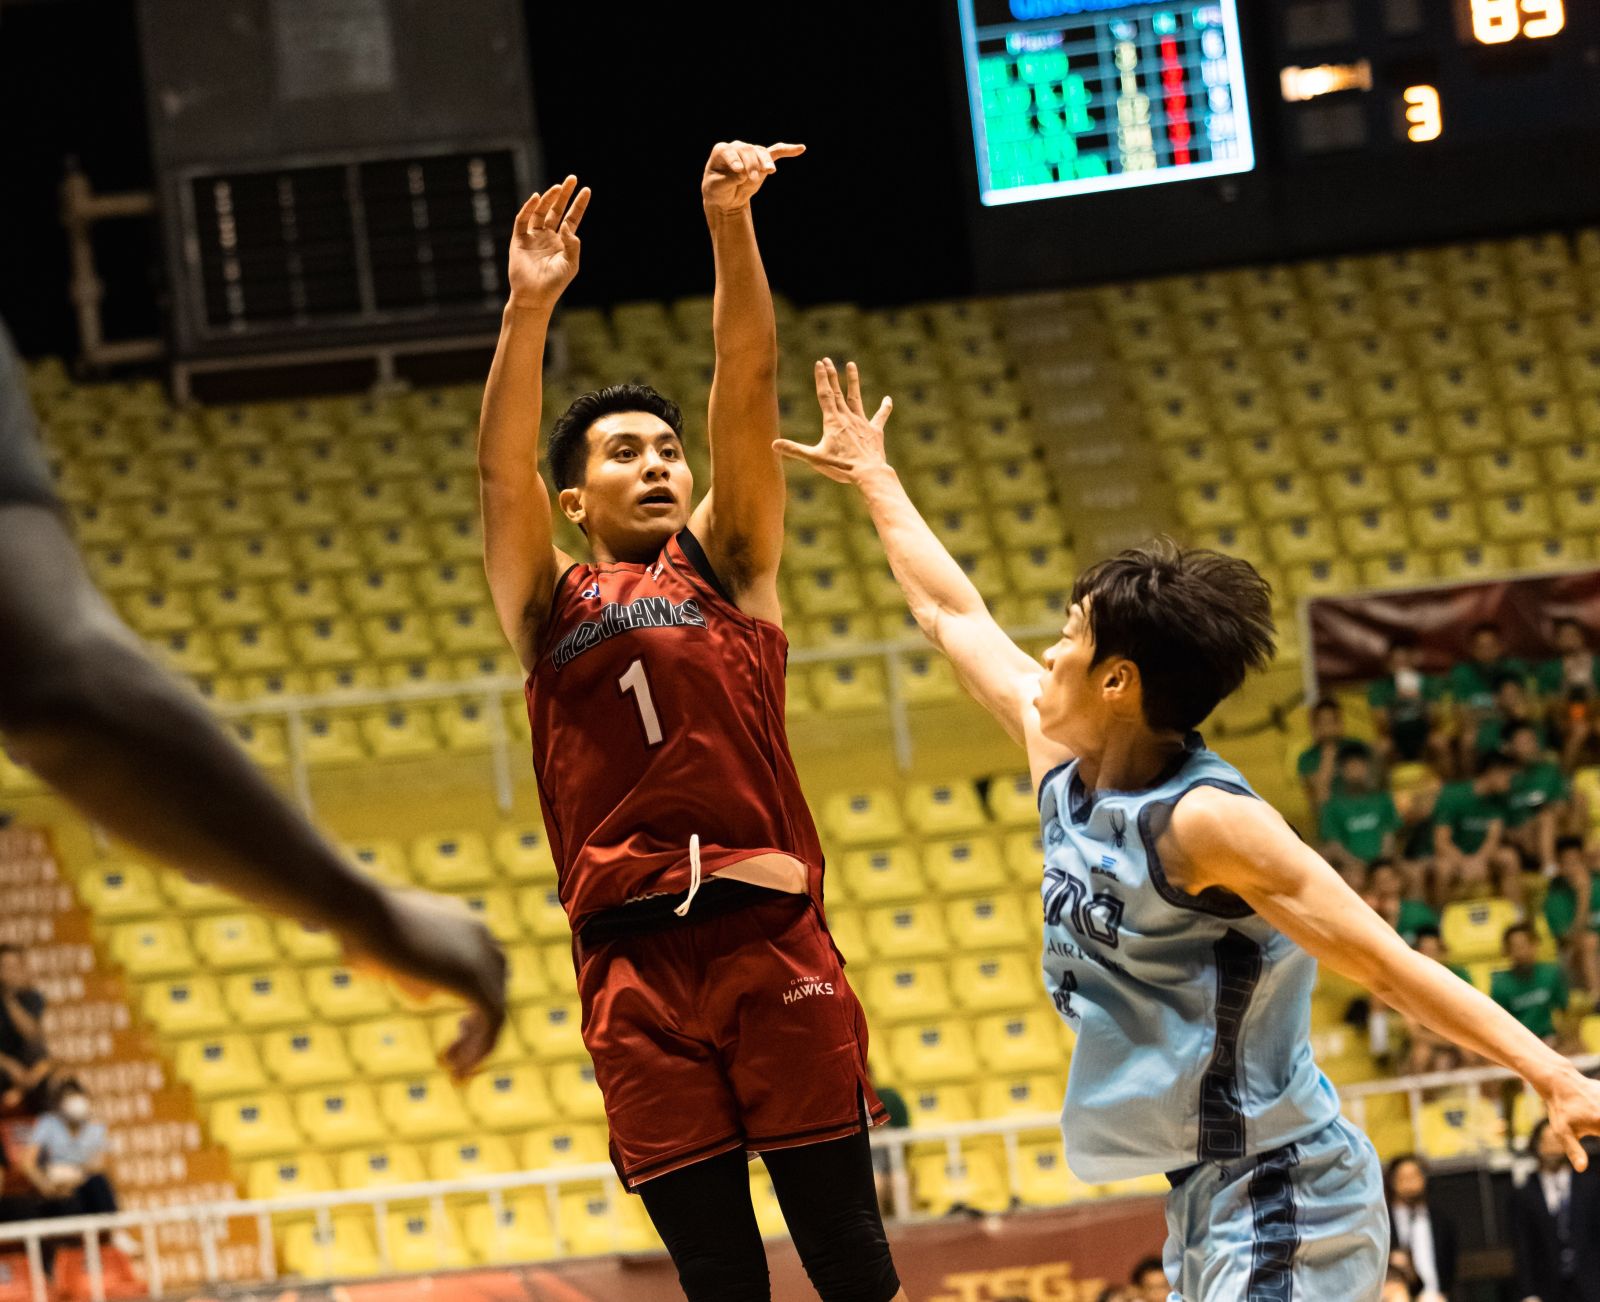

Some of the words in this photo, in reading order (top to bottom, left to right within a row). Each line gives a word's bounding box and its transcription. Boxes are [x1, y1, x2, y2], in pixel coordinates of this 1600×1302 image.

[1403, 85, 1442, 142] 3
[618, 658, 664, 746] 1
[783, 982, 834, 1005] HAWKS
